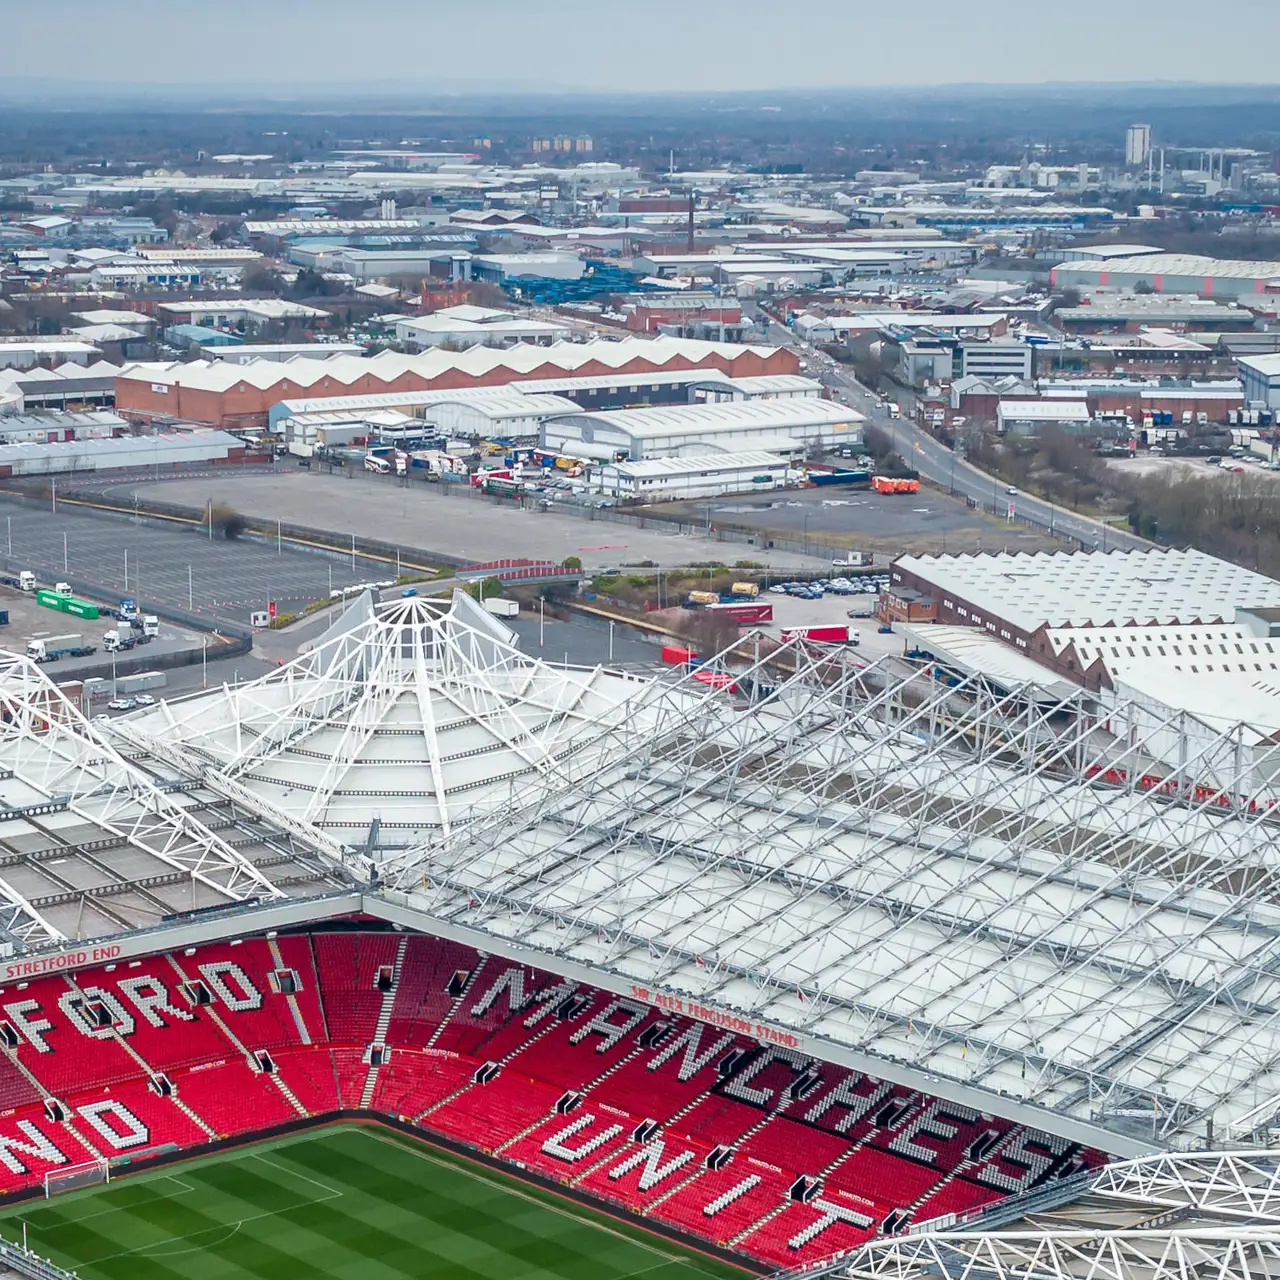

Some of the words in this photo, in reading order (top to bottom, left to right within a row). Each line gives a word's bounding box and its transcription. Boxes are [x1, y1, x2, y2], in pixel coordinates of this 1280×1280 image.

[6, 951, 87, 978] STRETFORD
[93, 945, 121, 964] END
[631, 985, 650, 1000] SIR
[654, 992, 683, 1014] ALEX
[688, 1001, 752, 1033] FERGUSON
[755, 1023, 798, 1048] STAND
[541, 1112, 875, 1250] UNIT
